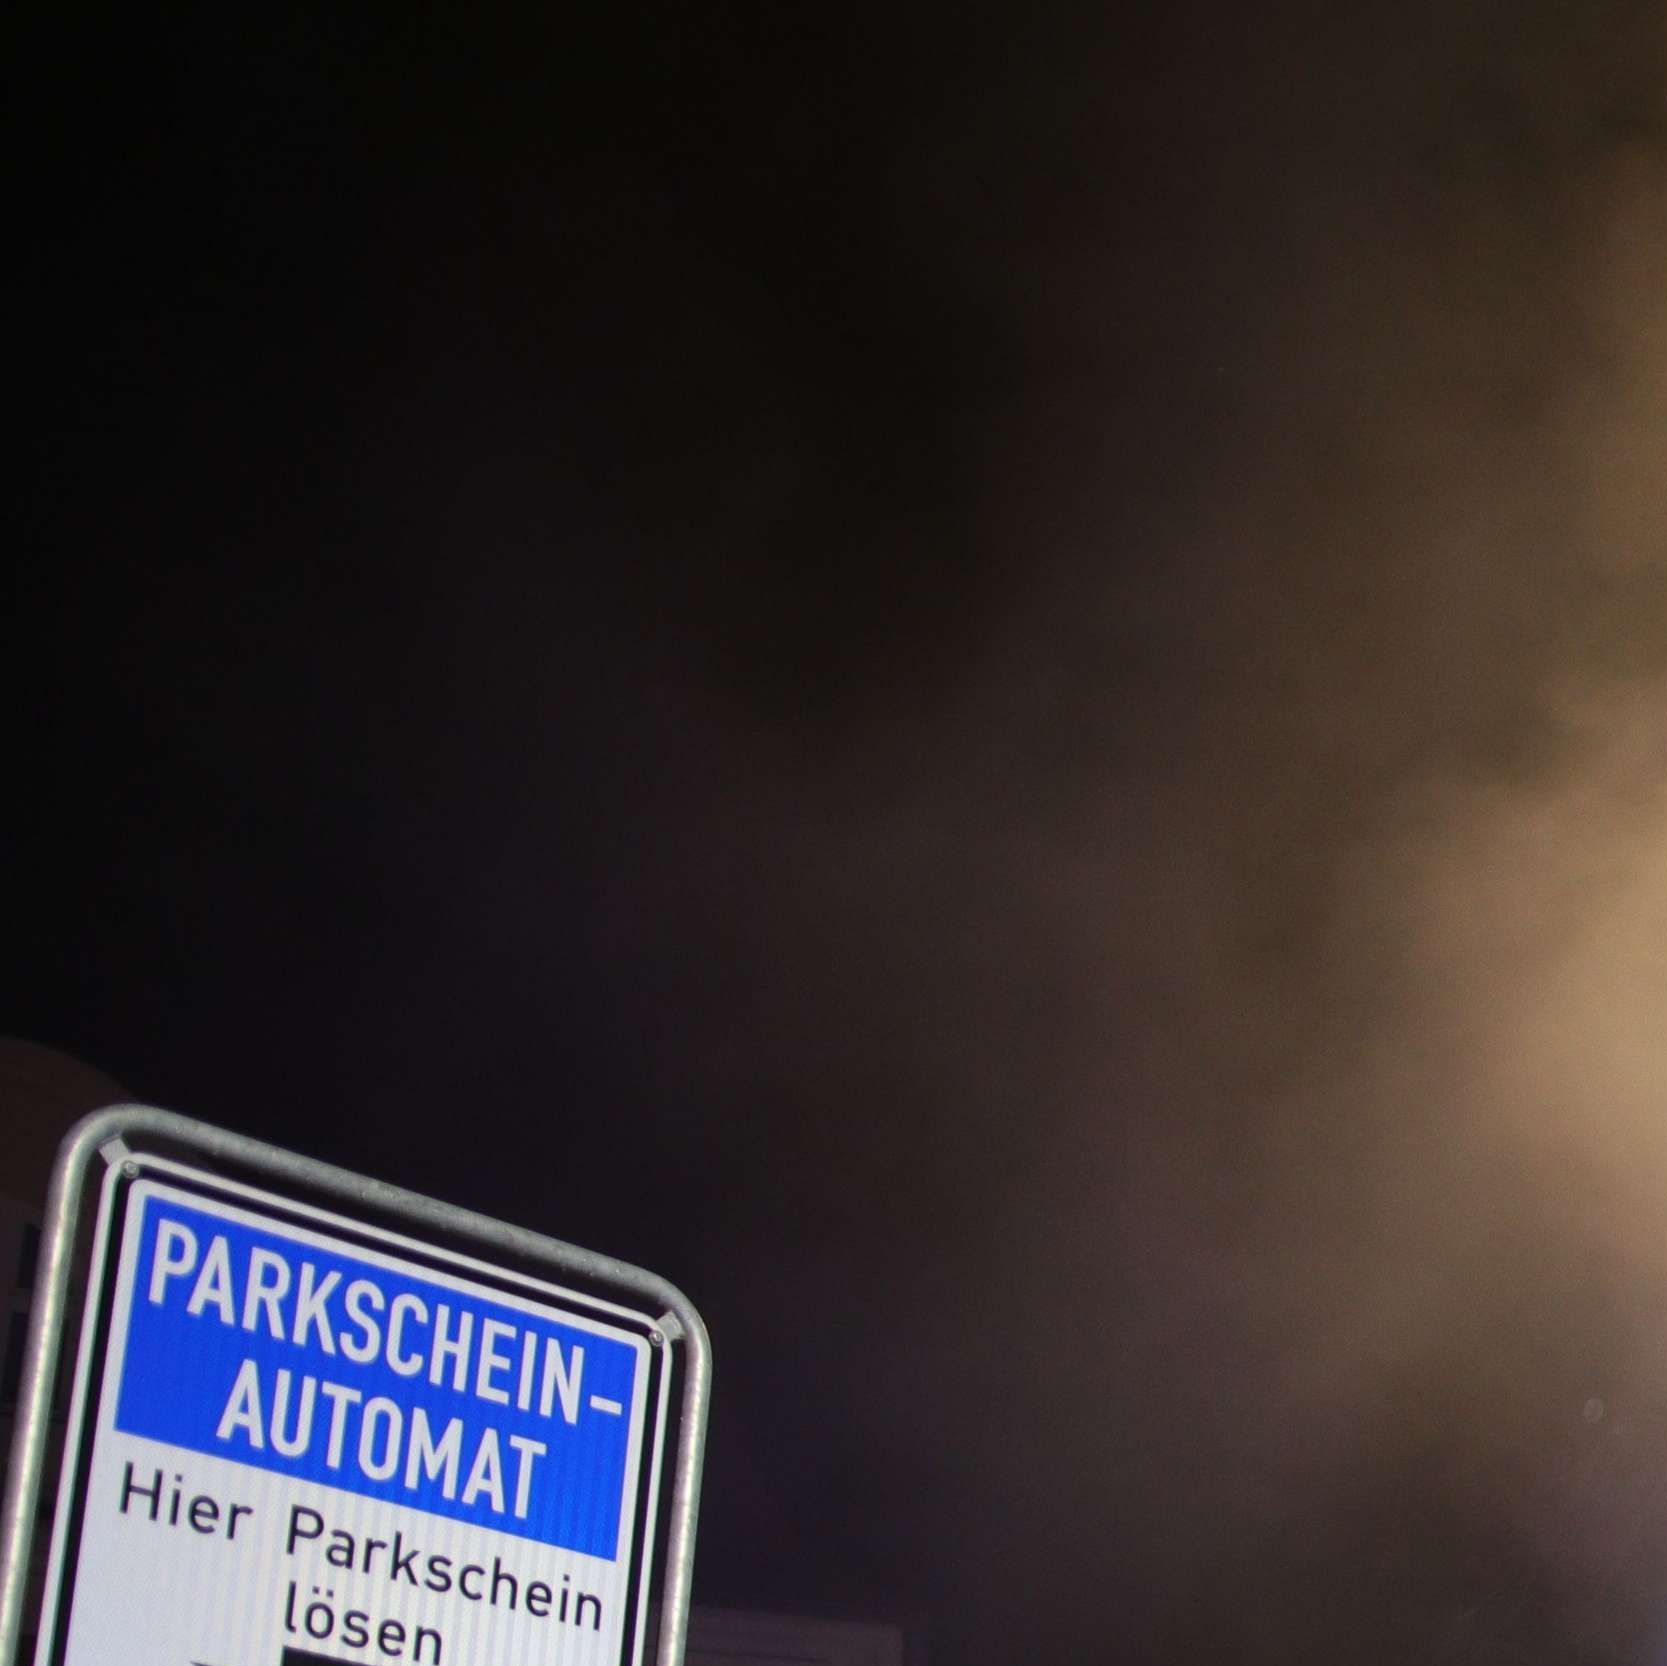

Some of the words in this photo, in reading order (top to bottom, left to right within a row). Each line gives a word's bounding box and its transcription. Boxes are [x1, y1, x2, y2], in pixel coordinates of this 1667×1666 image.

[148, 1216, 623, 1425] PARKSCHEIN-
[216, 1358, 547, 1519] AUTOMAT
[118, 1461, 253, 1541] Hier
[285, 1505, 604, 1632] Parkschein
